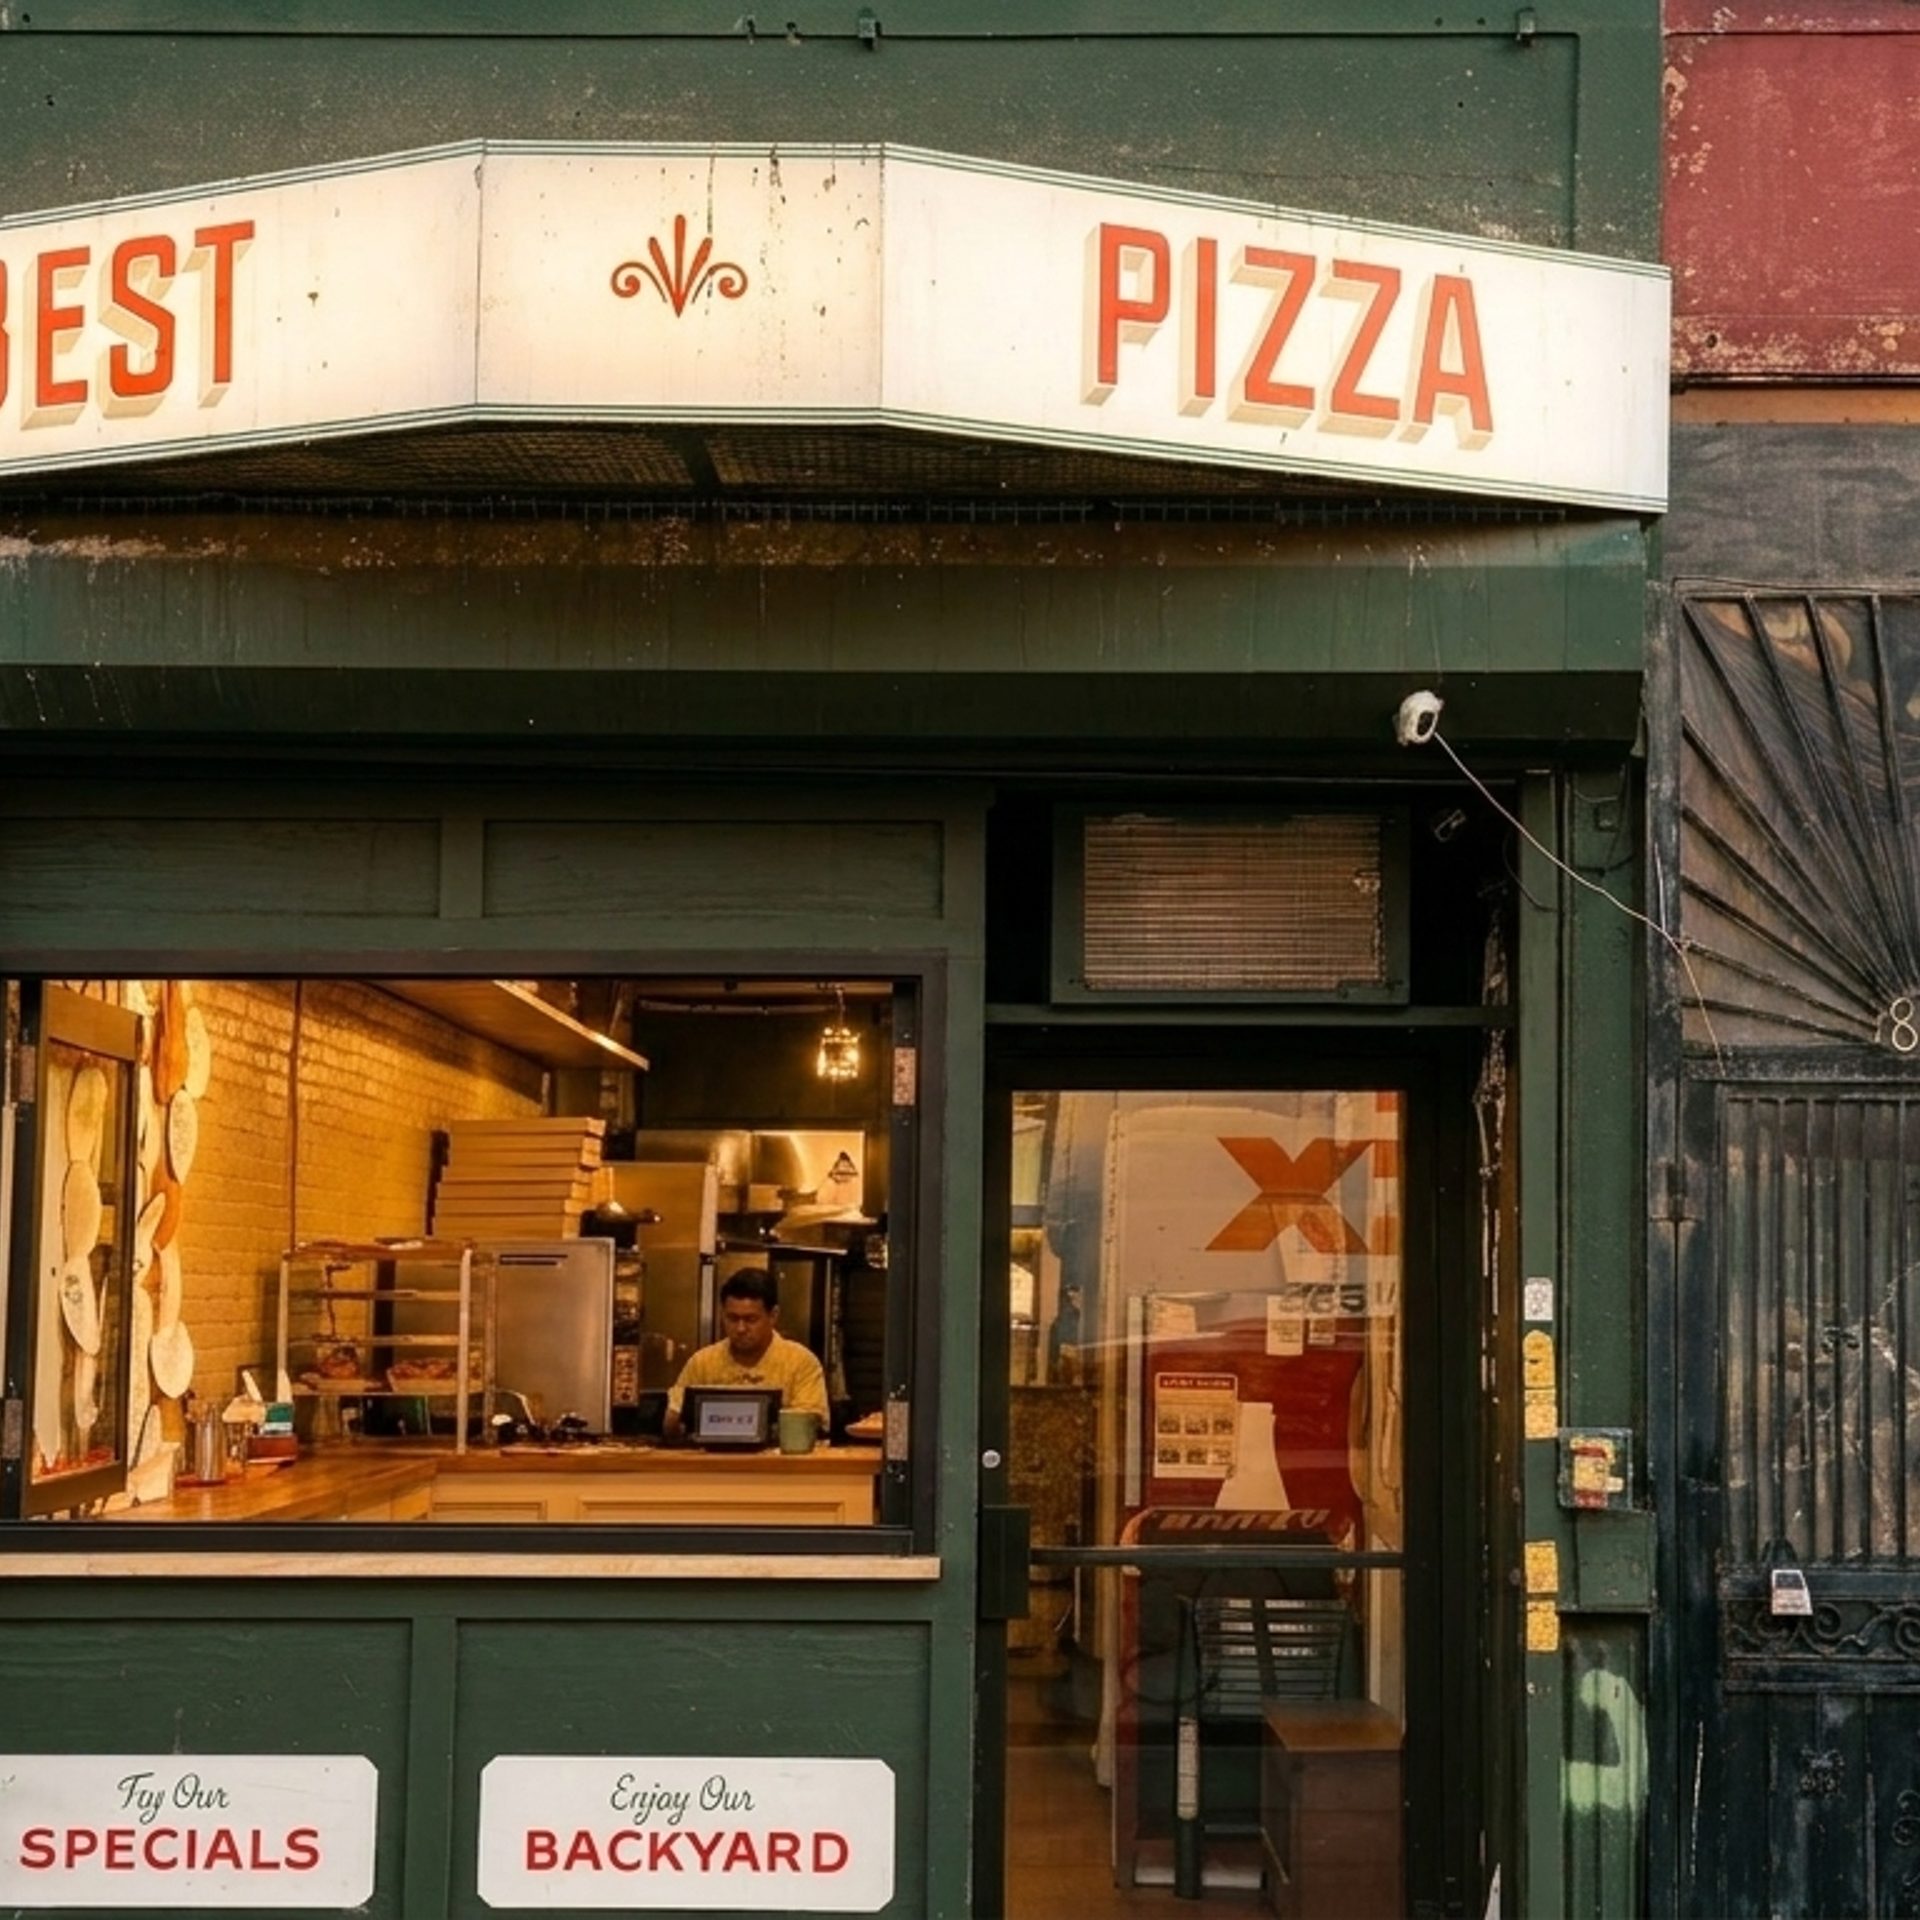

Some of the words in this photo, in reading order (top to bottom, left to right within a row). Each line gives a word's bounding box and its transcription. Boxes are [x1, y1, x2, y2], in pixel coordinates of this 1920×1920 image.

[0, 219, 256, 420] EST
[1086, 222, 1494, 444] PIZZA
[173, 1772, 230, 1809] Our
[699, 1774, 755, 1811] Our
[19, 1828, 321, 1871] SPECIALS
[525, 1830, 849, 1874] BACKYARD
